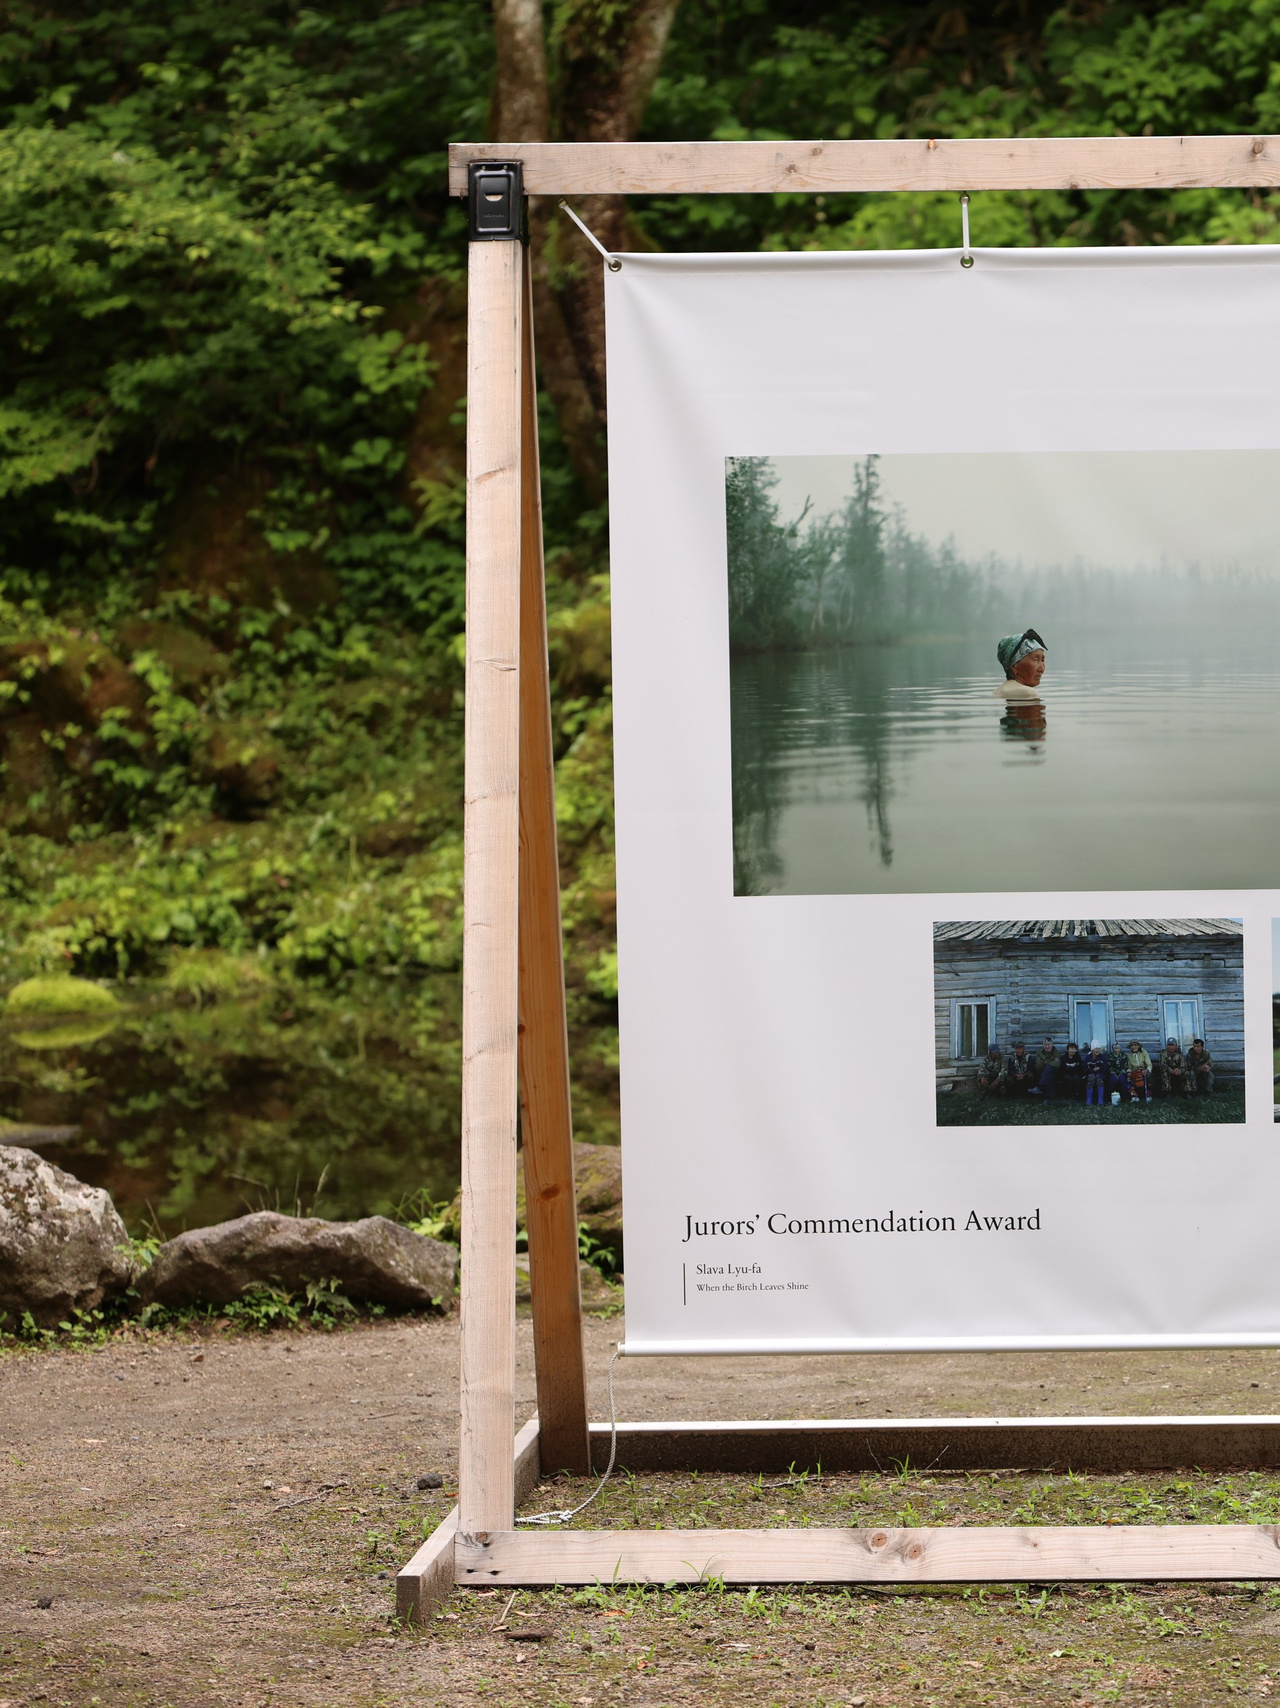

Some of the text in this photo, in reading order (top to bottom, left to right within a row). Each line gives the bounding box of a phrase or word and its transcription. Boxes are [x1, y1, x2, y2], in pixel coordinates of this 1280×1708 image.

[682, 1208, 1042, 1243] Jurors’ Commendation Award
[696, 1262, 761, 1278] Slava Lyu-fa
[696, 1281, 809, 1292] When the Birch Leaves Shine
